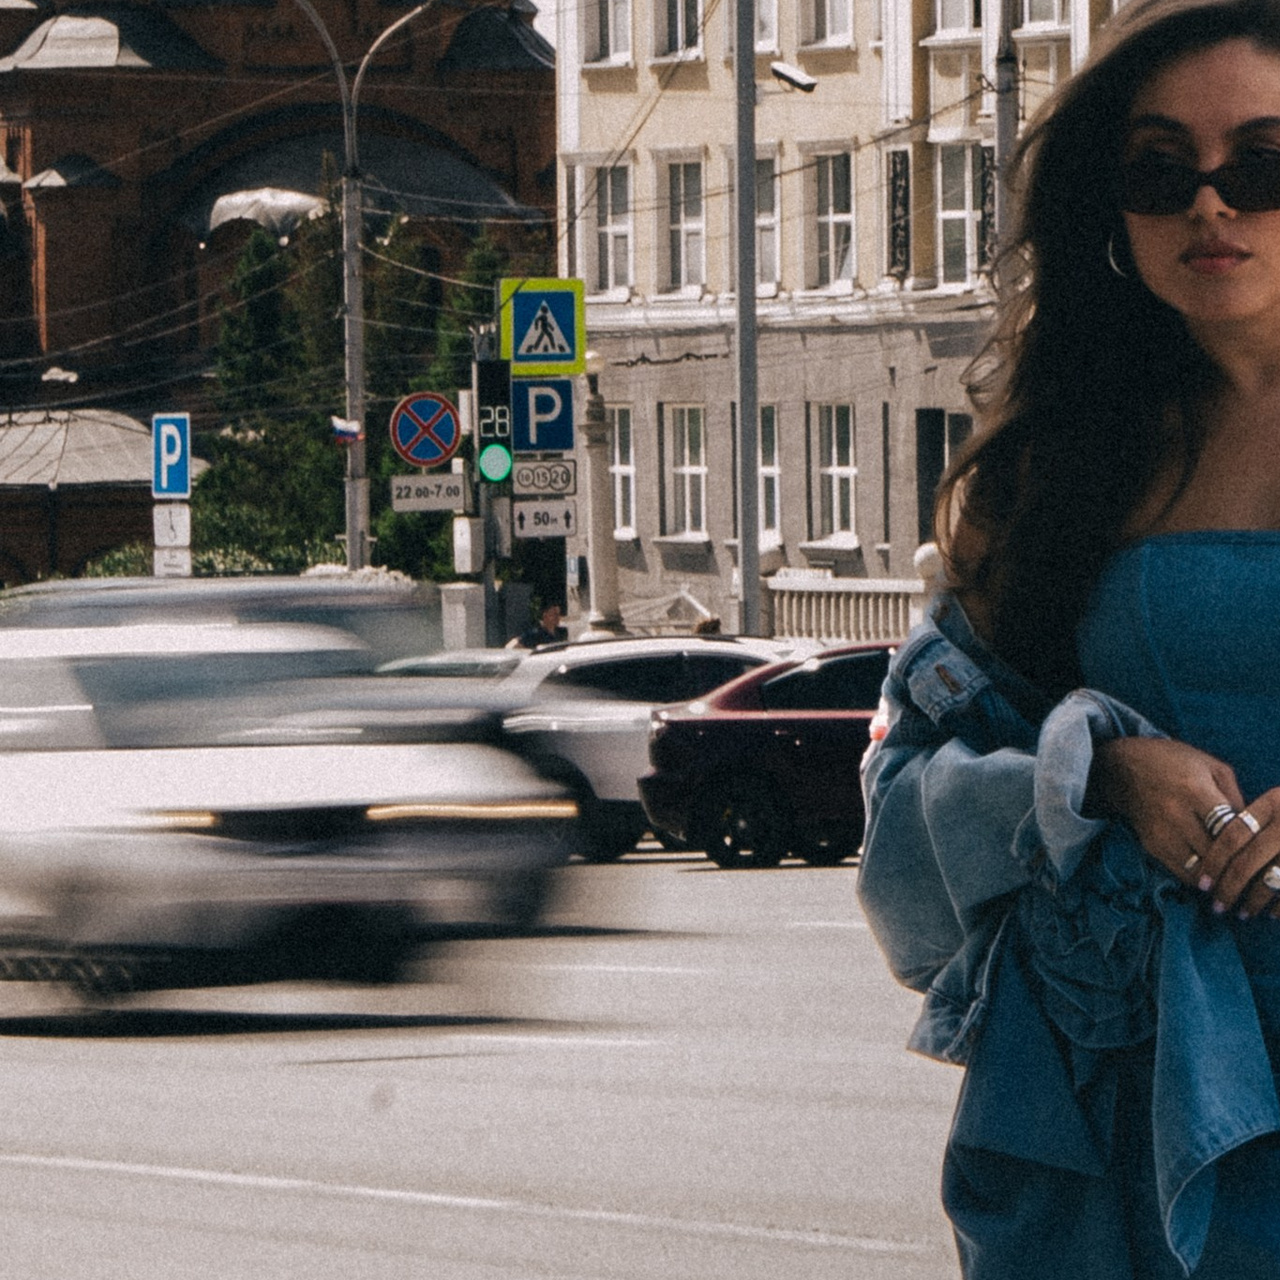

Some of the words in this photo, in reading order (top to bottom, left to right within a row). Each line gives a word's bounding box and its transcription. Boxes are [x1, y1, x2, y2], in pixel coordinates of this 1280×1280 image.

[480, 406, 510, 438] 28
[528, 386, 562, 445] P
[160, 423, 182, 489] P
[536, 471, 549, 484] 15
[552, 470, 569, 485] 20
